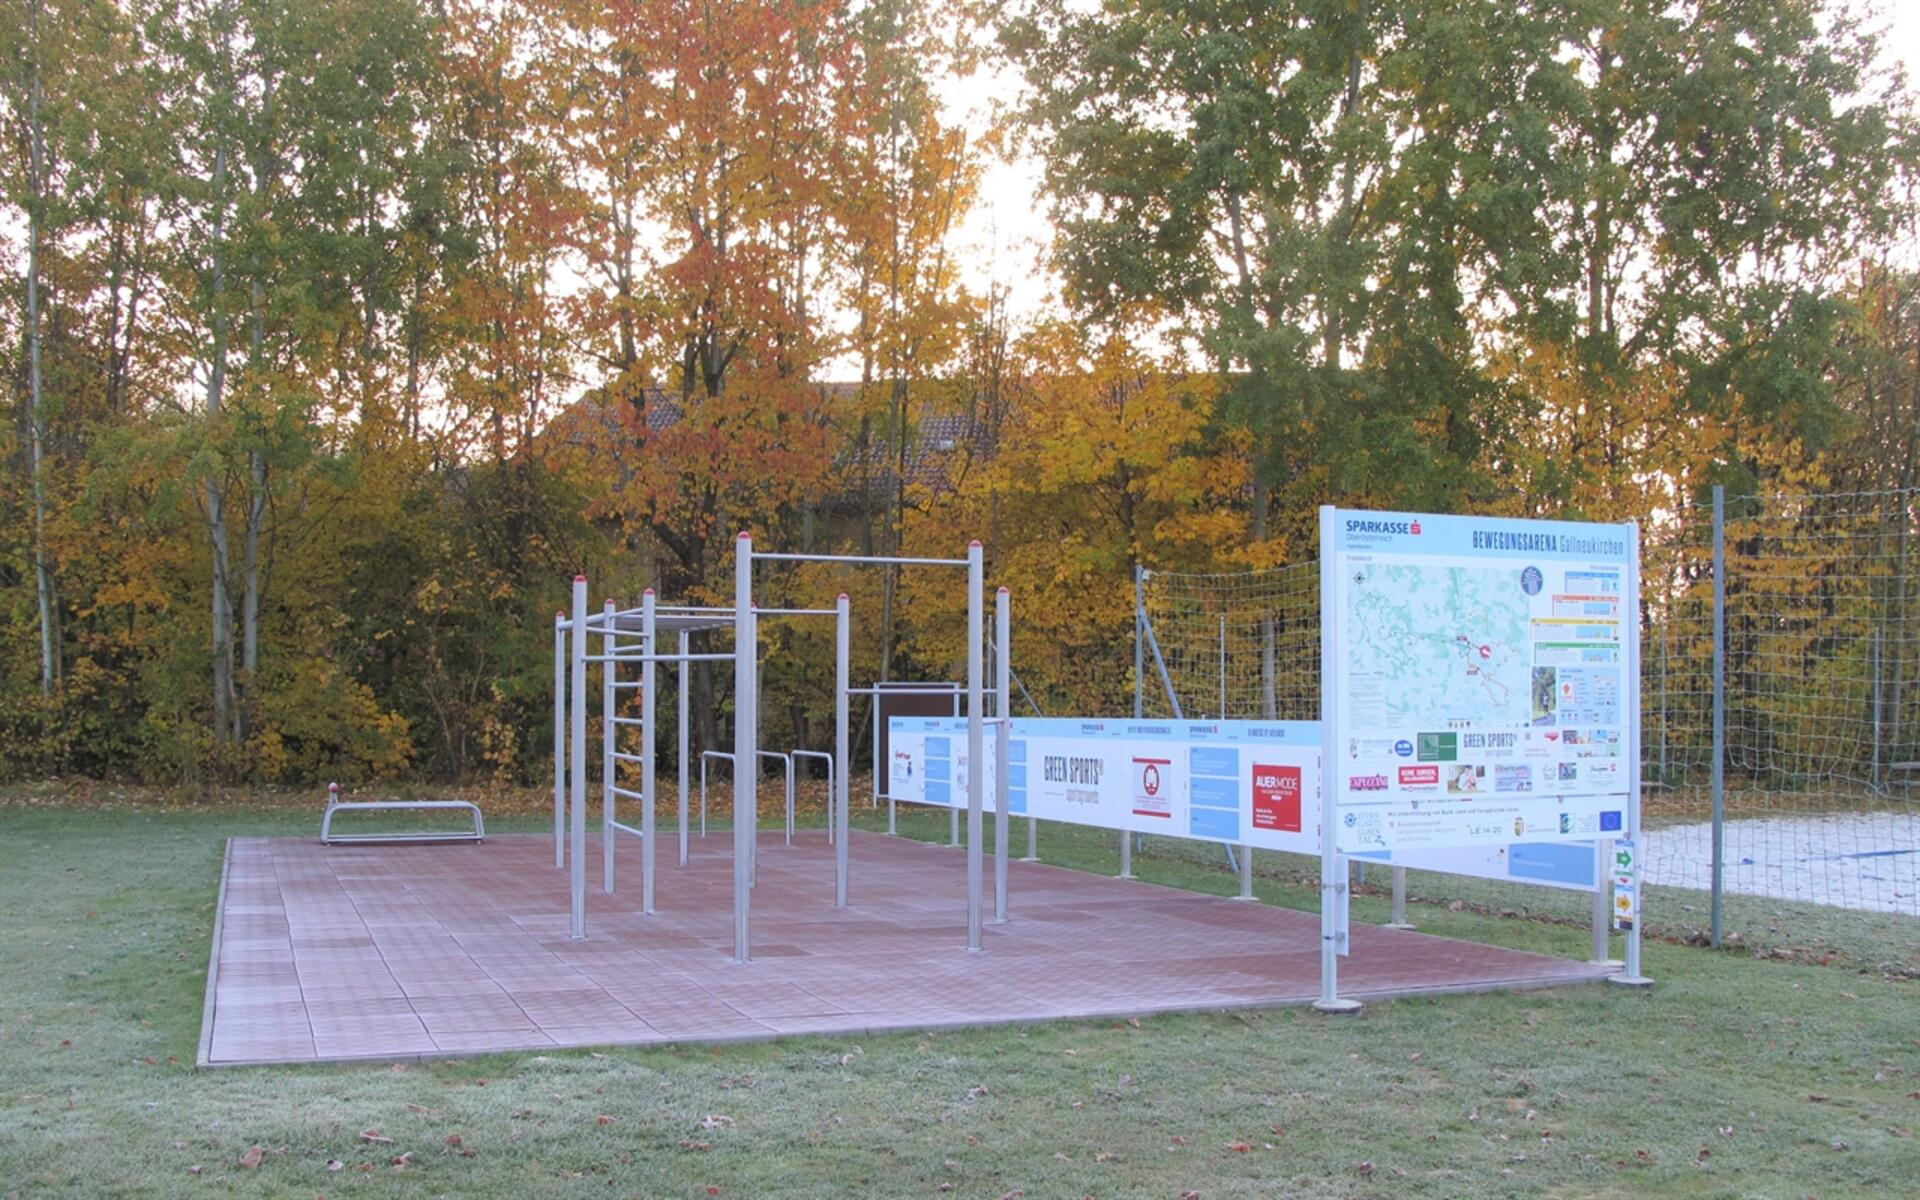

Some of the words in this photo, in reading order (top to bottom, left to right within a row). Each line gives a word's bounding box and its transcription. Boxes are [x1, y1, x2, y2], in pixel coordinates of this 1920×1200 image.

[1346, 520, 1409, 534] SPARKASSE
[1473, 531, 1557, 552] BEWEGUNGSARENA
[1559, 535, 1624, 556] Gallneukirchen
[1463, 733, 1486, 748] GREEN
[1044, 756, 1068, 782] GREEN
